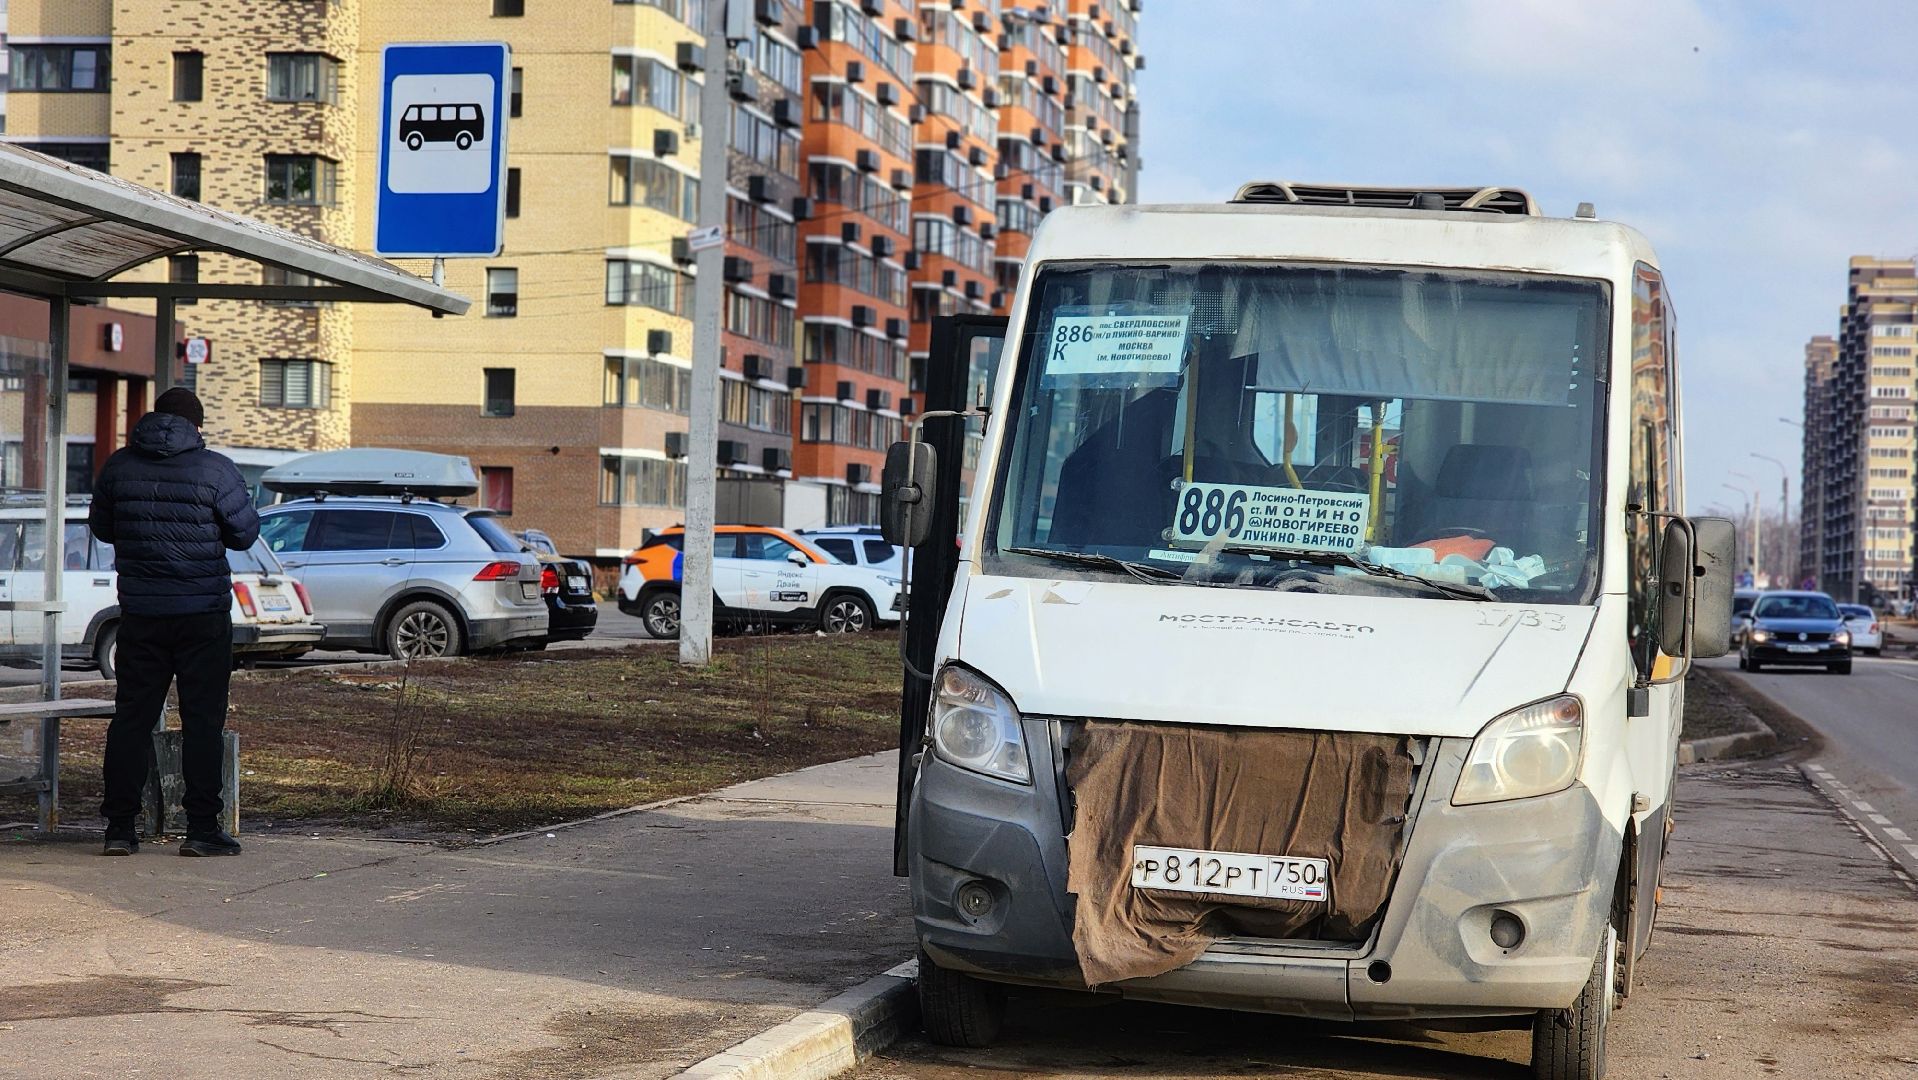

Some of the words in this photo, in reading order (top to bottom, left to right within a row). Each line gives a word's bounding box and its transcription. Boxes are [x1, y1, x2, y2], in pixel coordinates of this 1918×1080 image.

[1055, 325, 1093, 343] 886
[1052, 342, 1068, 361] К
[1118, 342, 1153, 351] МОСКВА
[1252, 491, 1363, 509] Лосино-Петровский
[1179, 487, 1247, 538] 886
[1250, 506, 1262, 515] ст.
[1262, 517, 1359, 535] НОВОГИРЕЕВО
[1272, 861, 1317, 884] 750
[1281, 886, 1304, 895] RUS
